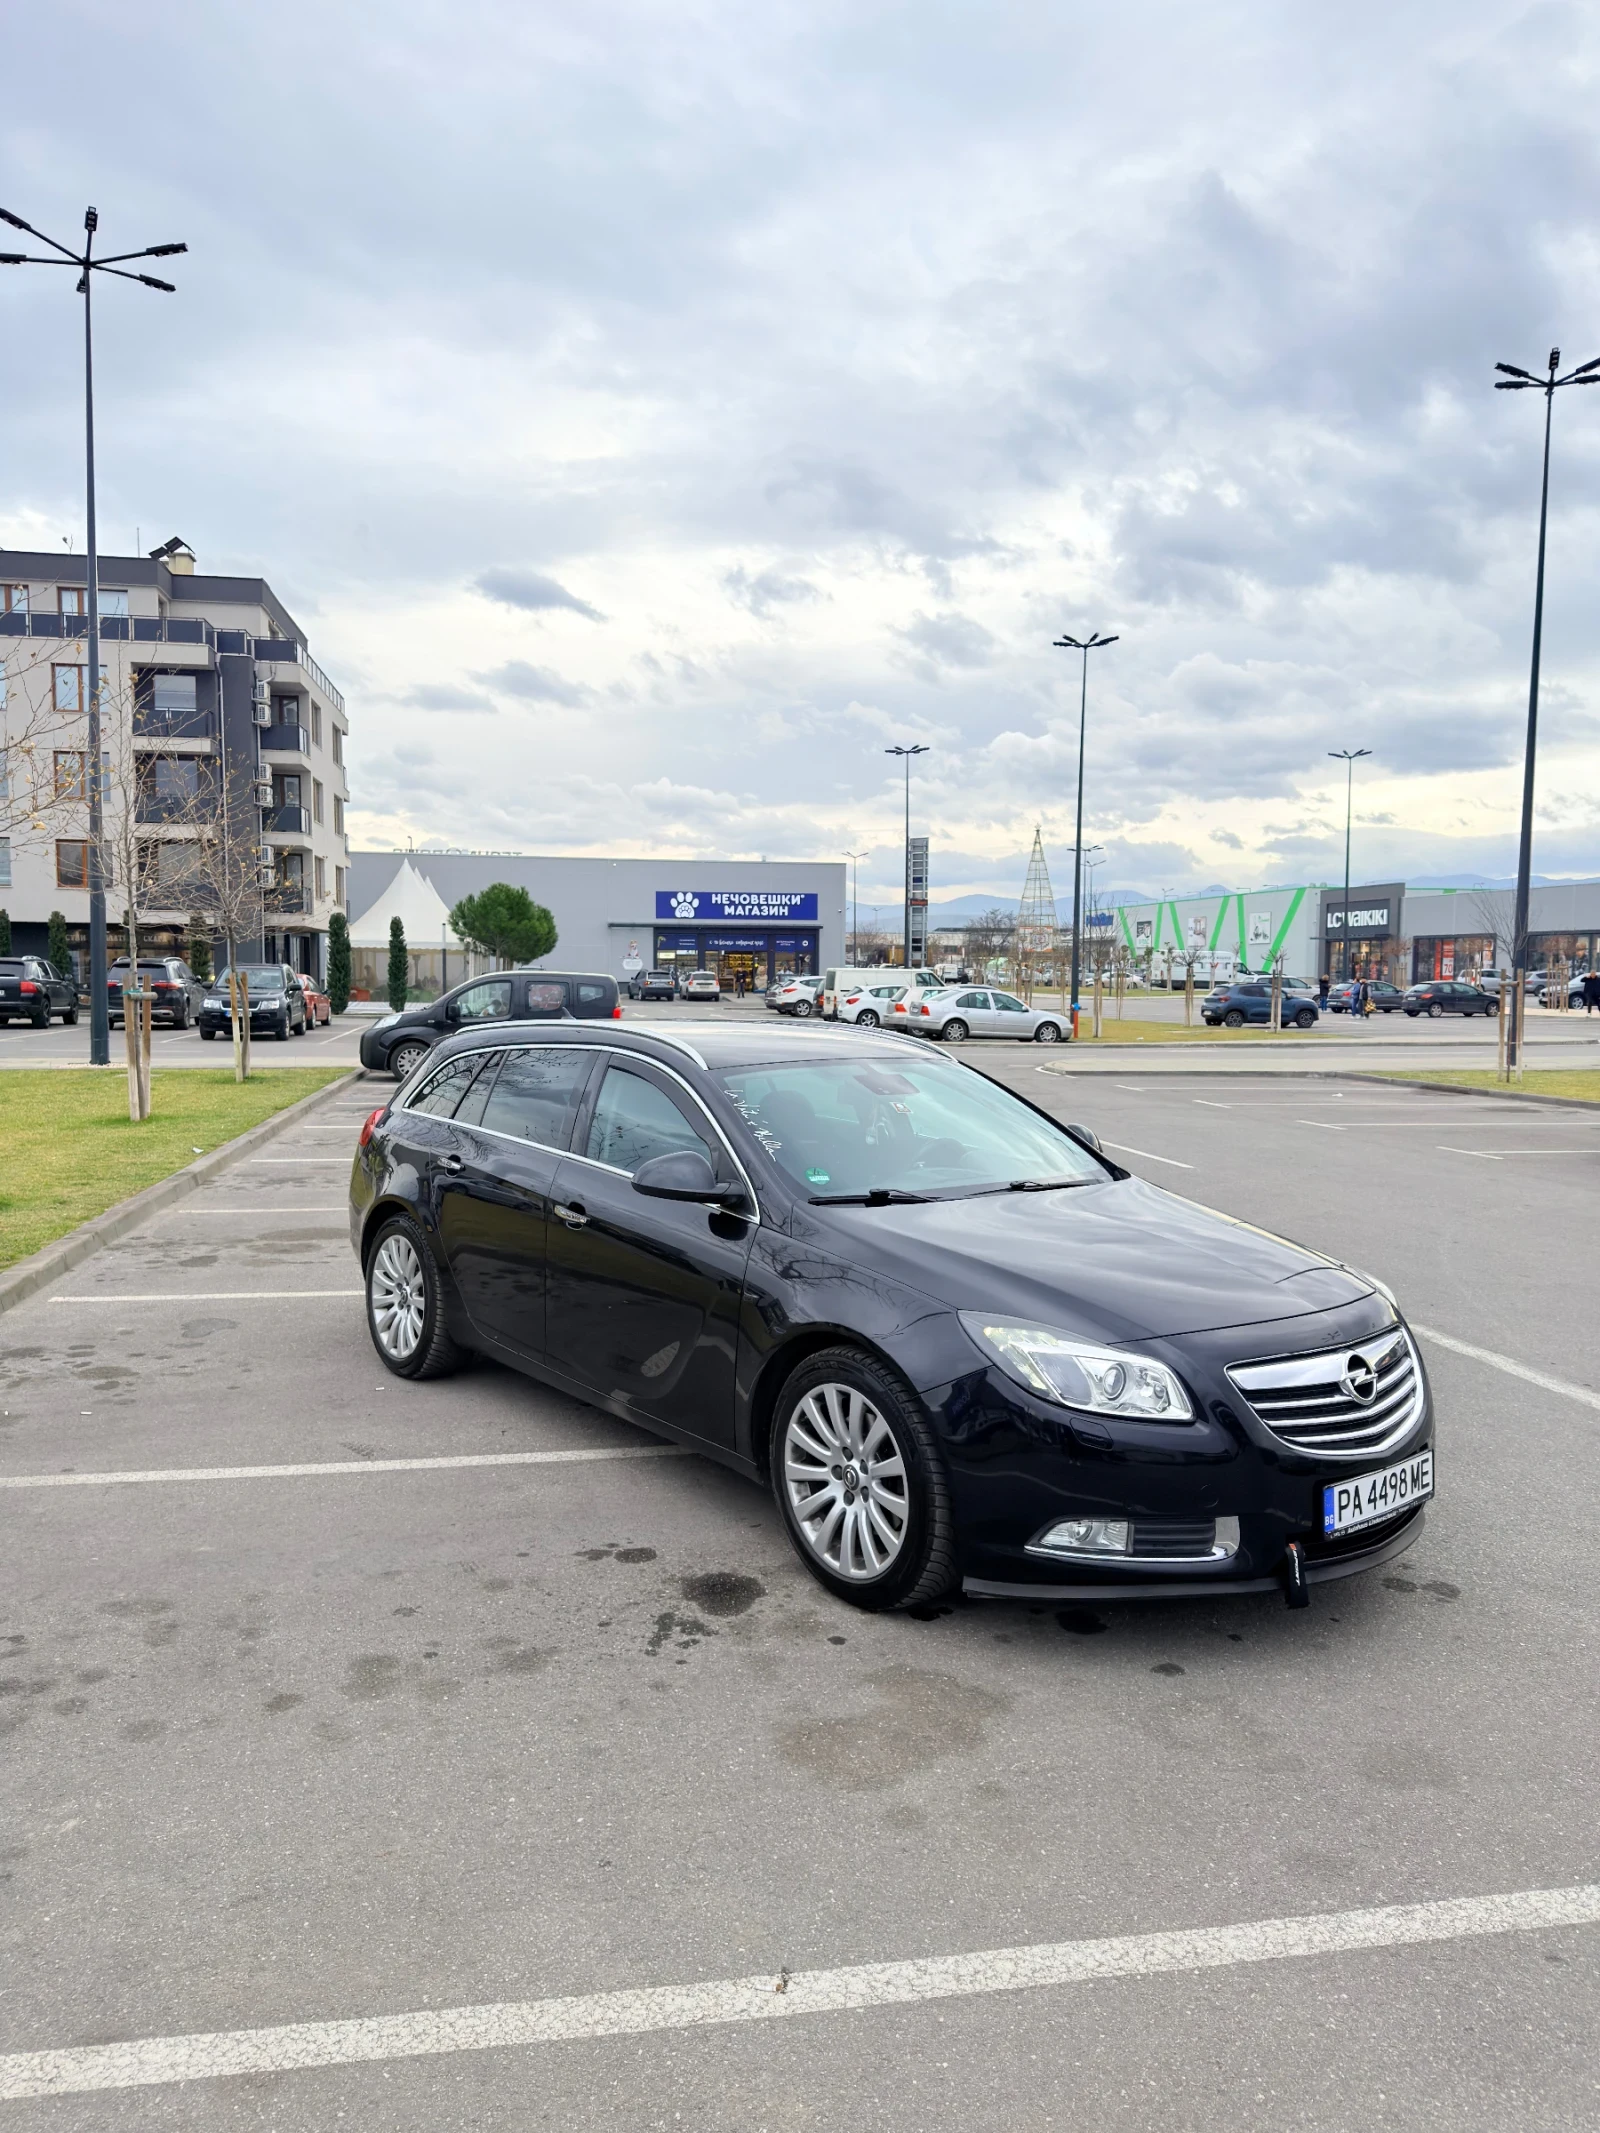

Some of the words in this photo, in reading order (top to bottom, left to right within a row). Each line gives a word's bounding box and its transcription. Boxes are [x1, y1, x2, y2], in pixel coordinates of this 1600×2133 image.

[724, 905, 788, 916] МАГАЗИН
[1338, 1485, 1363, 1523] PA
[1367, 1468, 1408, 1510] 4498
[1410, 1458, 1430, 1494] ME
[1324, 1514, 1334, 1526] BG
